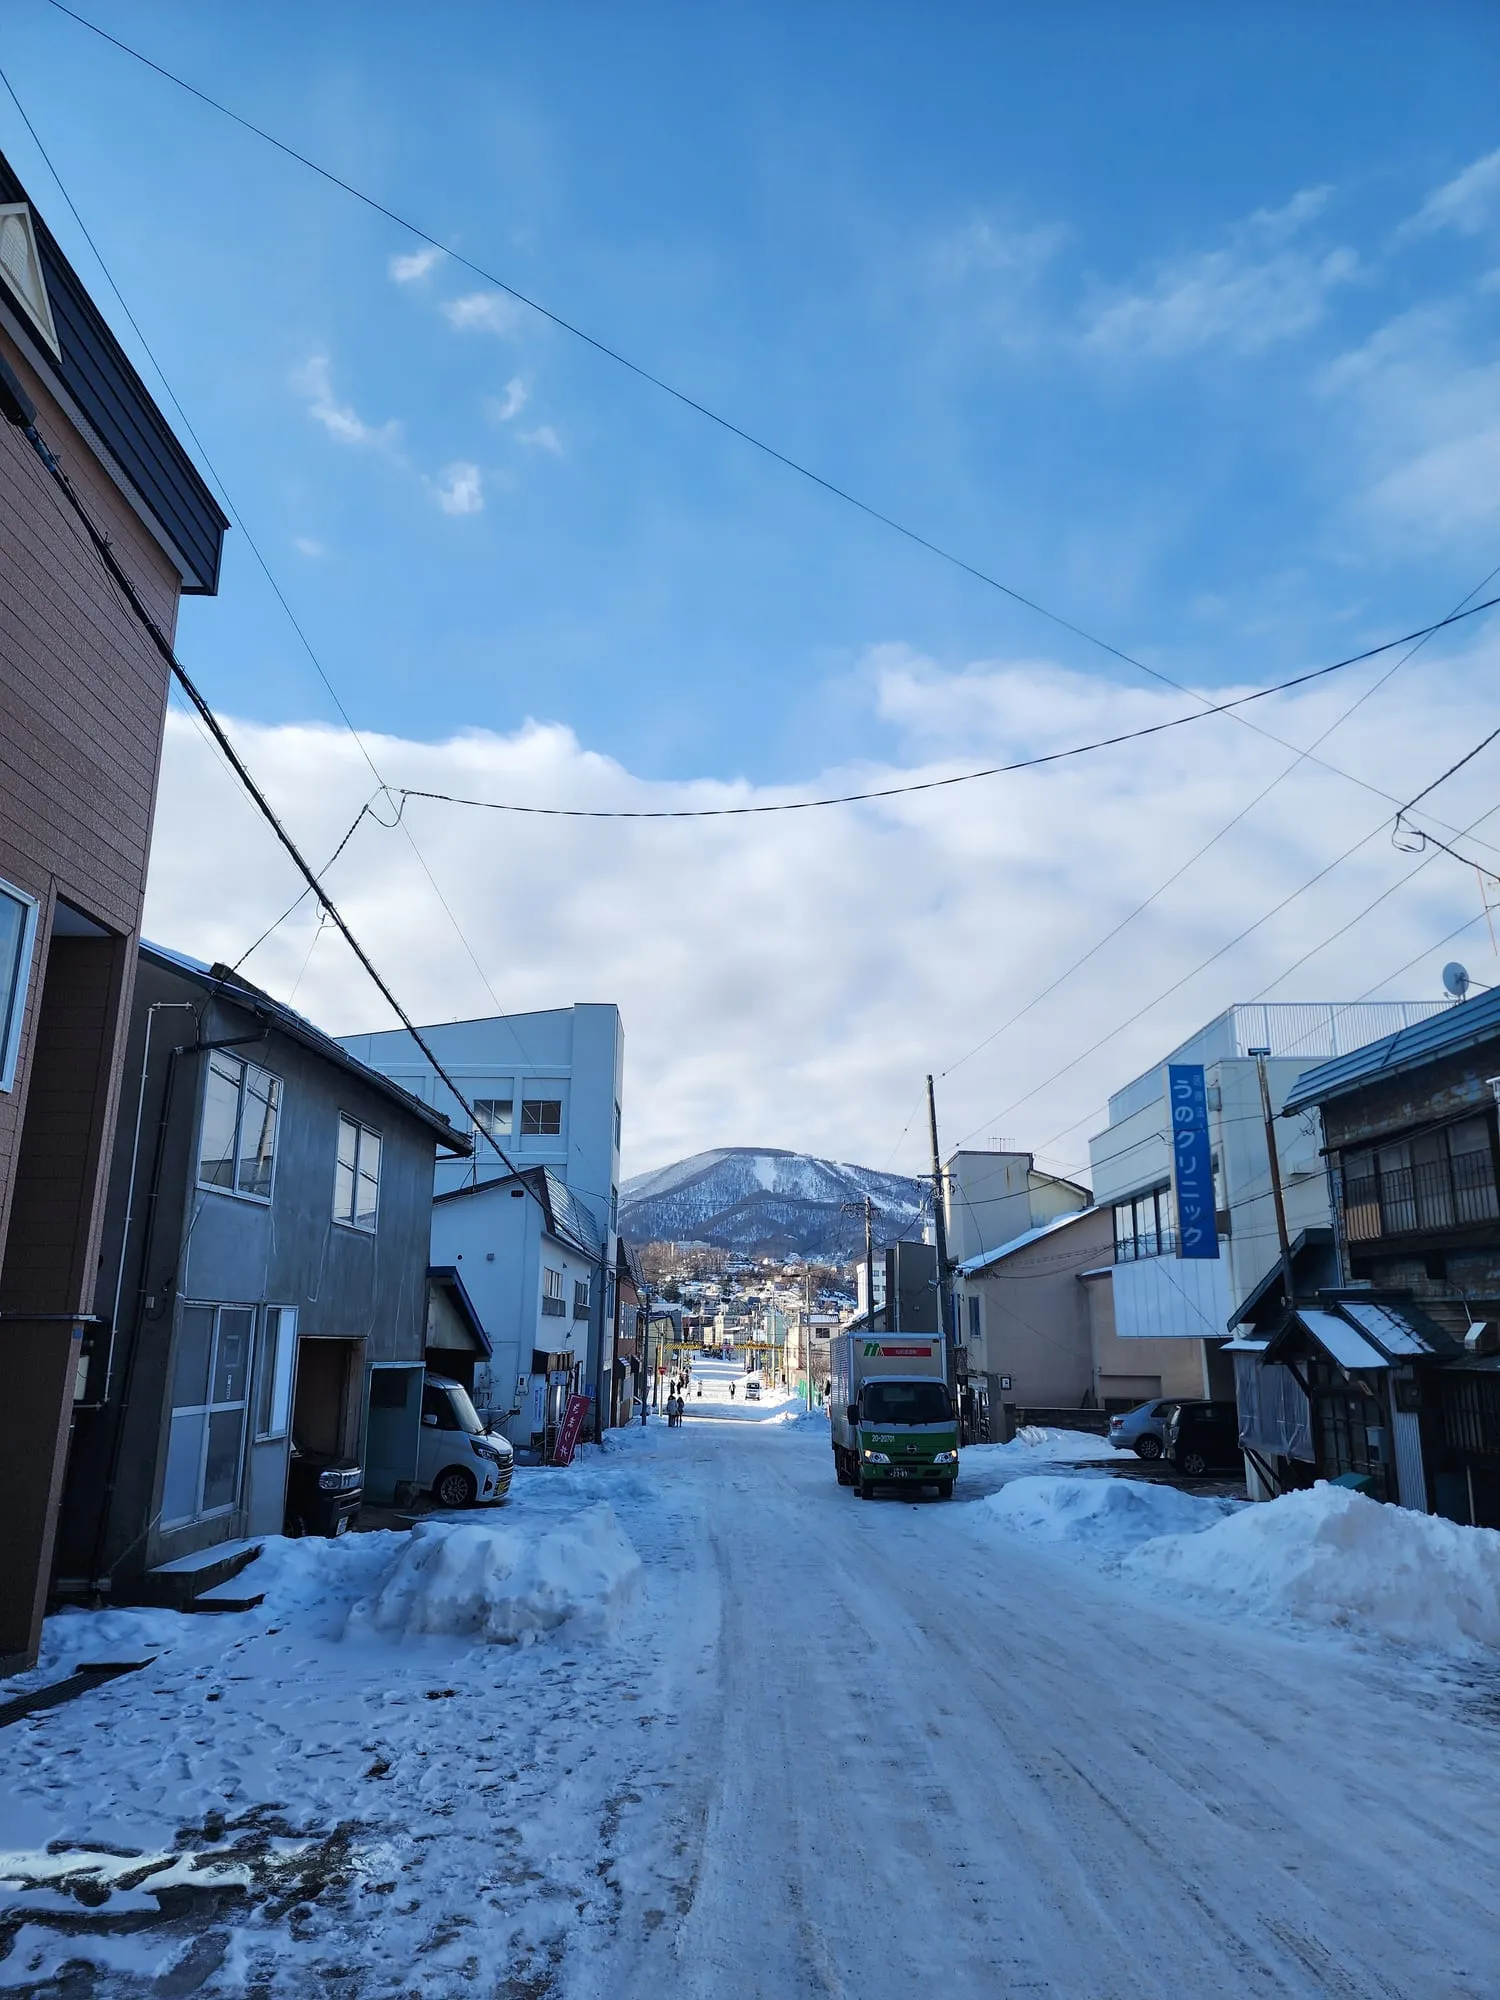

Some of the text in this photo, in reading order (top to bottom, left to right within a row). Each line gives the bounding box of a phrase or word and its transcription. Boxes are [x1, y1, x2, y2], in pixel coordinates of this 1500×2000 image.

[1173, 1079, 1202, 1246] うのクリニック
